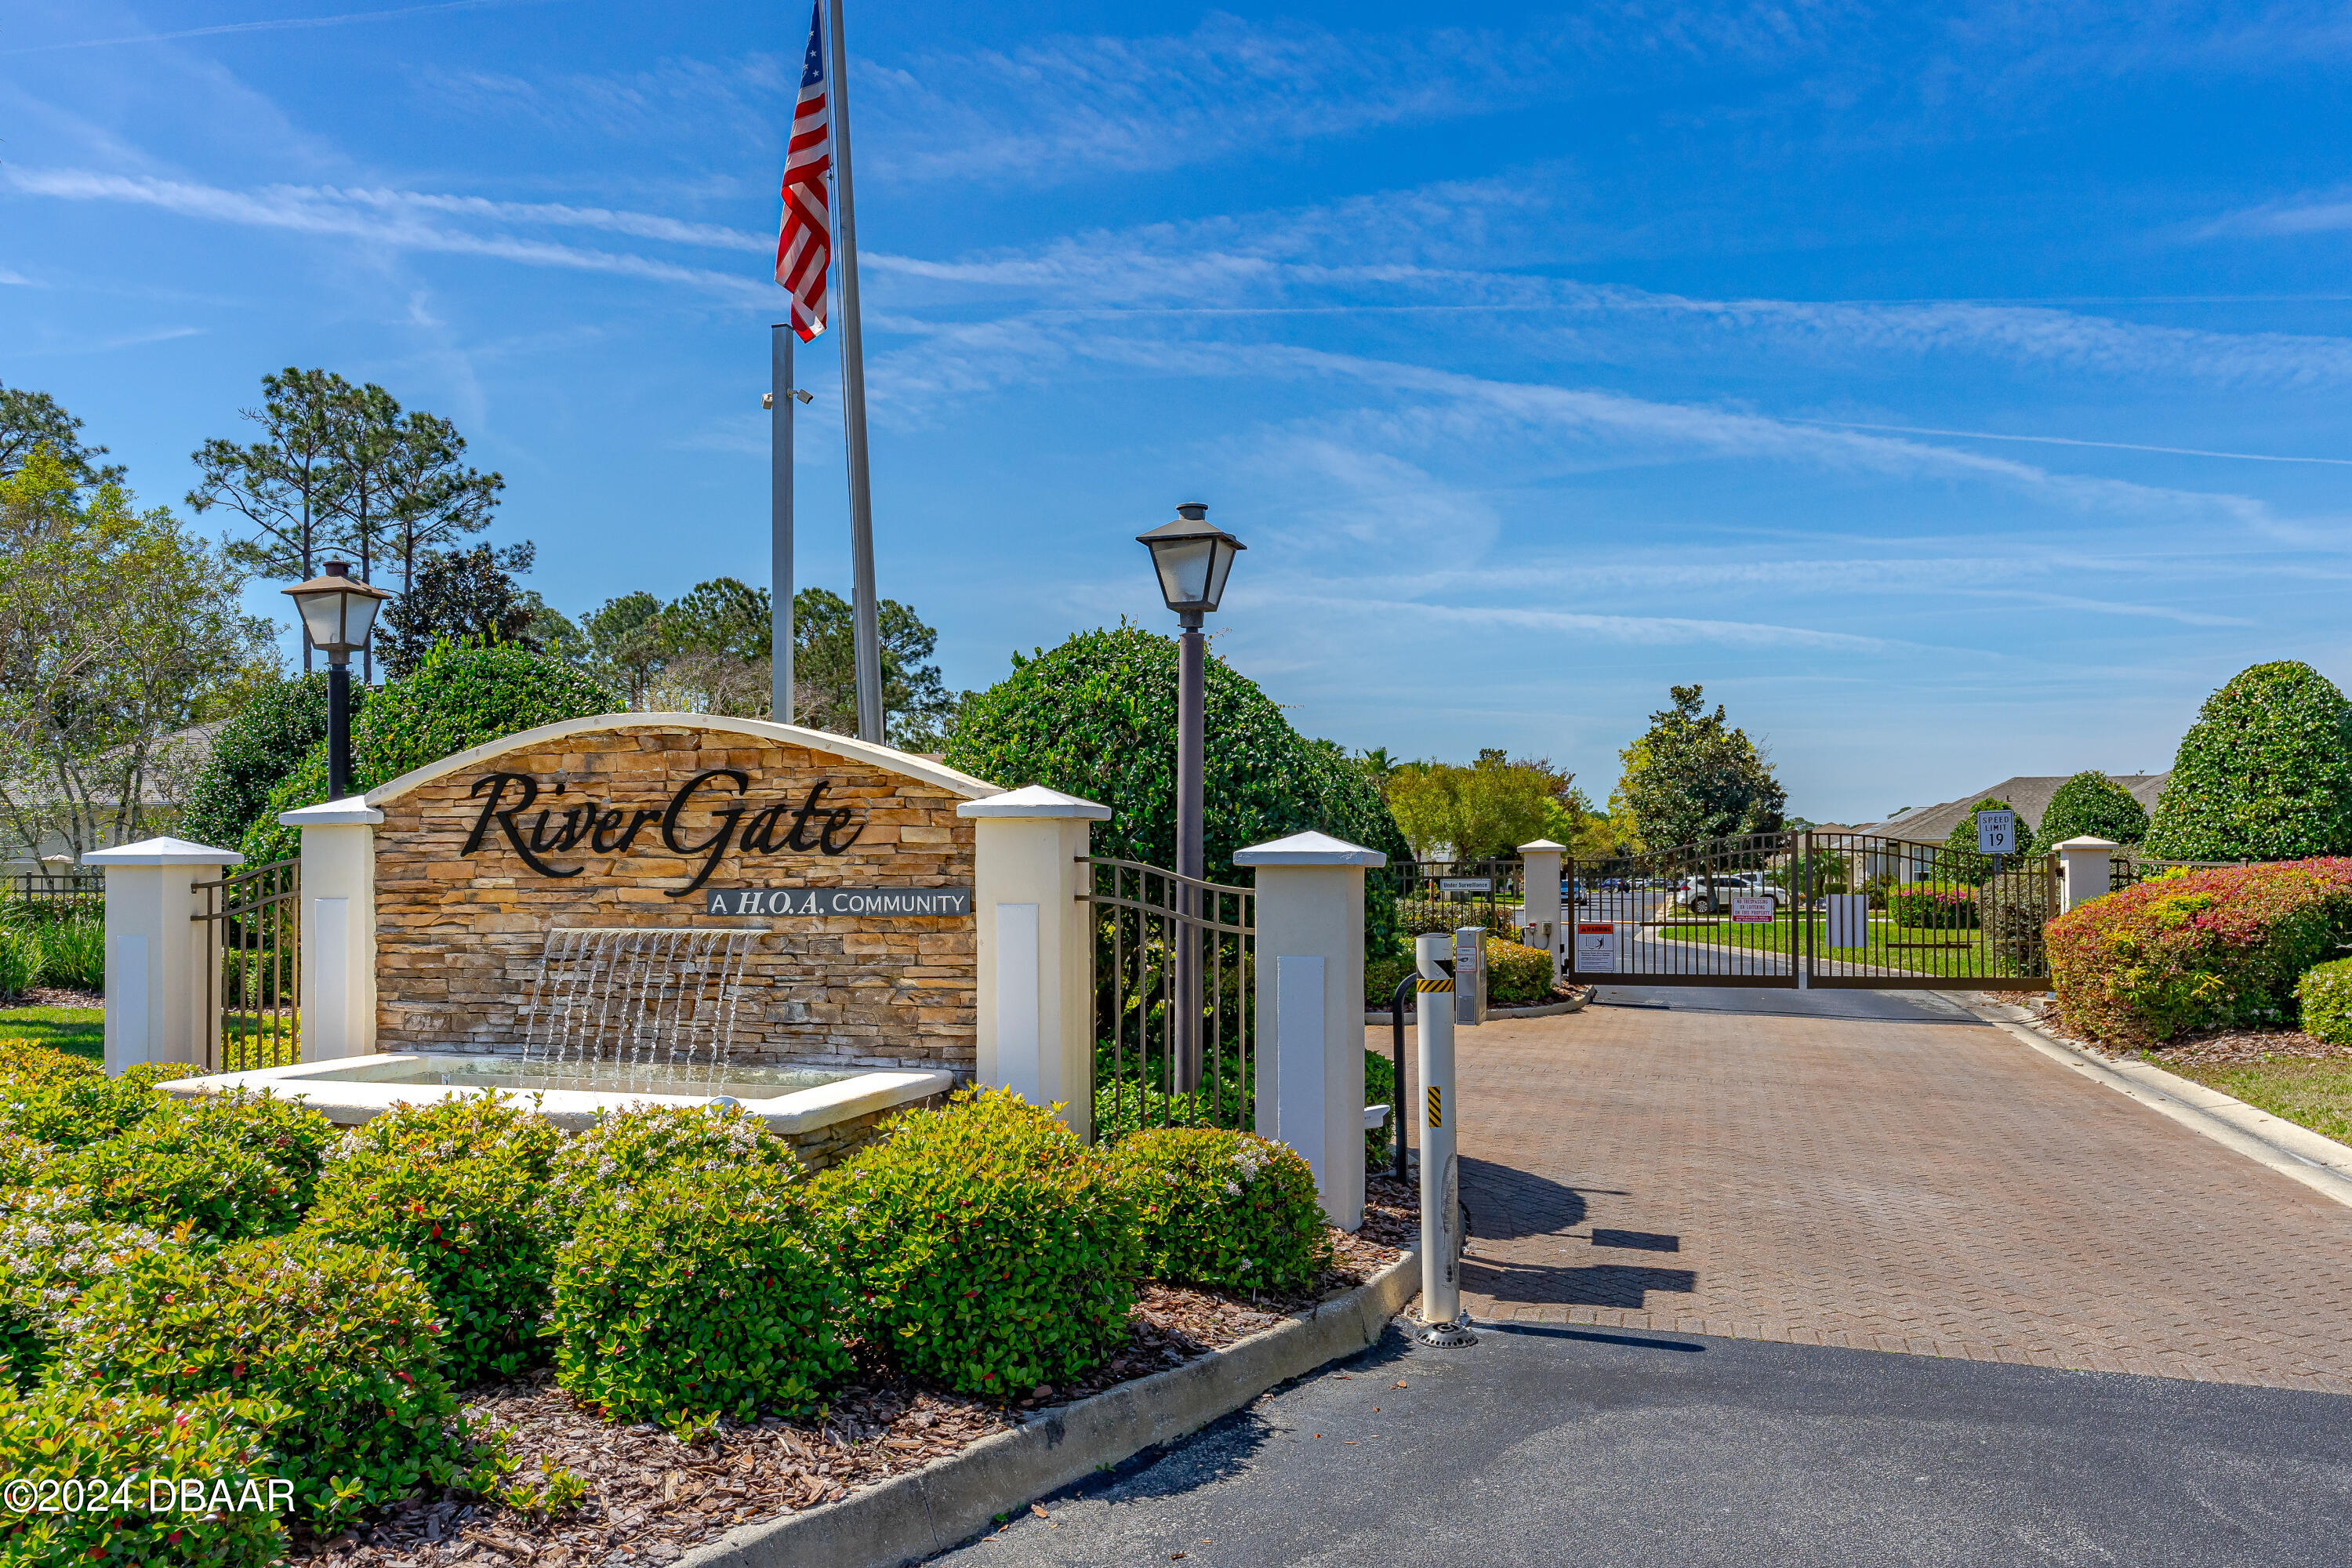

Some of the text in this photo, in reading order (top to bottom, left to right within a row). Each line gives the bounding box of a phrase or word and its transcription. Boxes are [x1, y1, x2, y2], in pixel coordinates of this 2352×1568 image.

[459, 769, 869, 897] RiverGate
[1989, 833, 2004, 847] 19
[710, 894, 728, 913] A
[735, 891, 825, 914] H.O.A.
